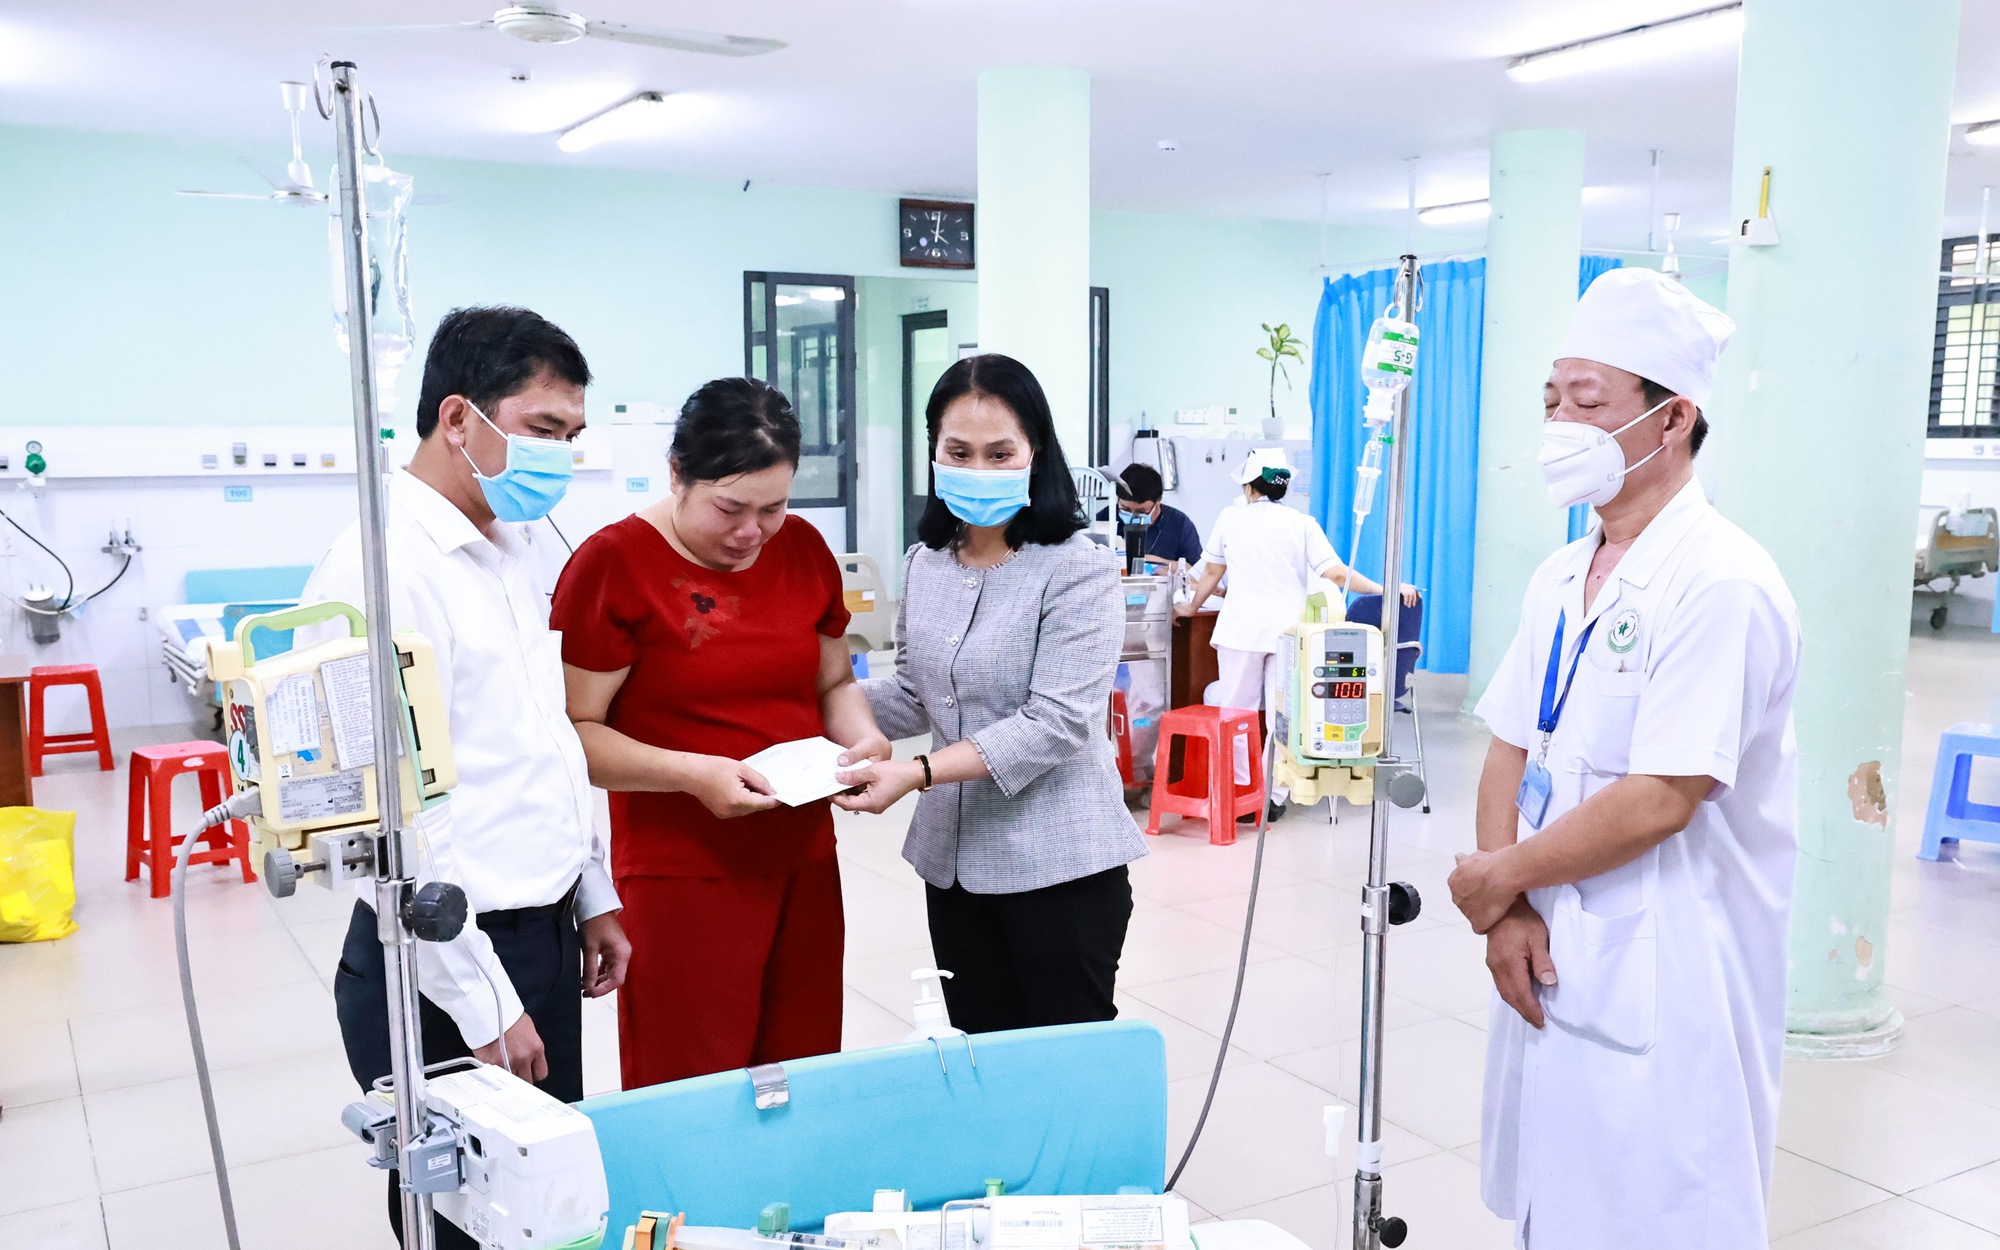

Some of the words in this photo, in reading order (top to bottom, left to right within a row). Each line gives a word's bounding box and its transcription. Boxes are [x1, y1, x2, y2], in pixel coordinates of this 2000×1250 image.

[1393, 350, 1413, 364] G-5
[1334, 682, 1363, 698] 100
[237, 739, 245, 773] 4
